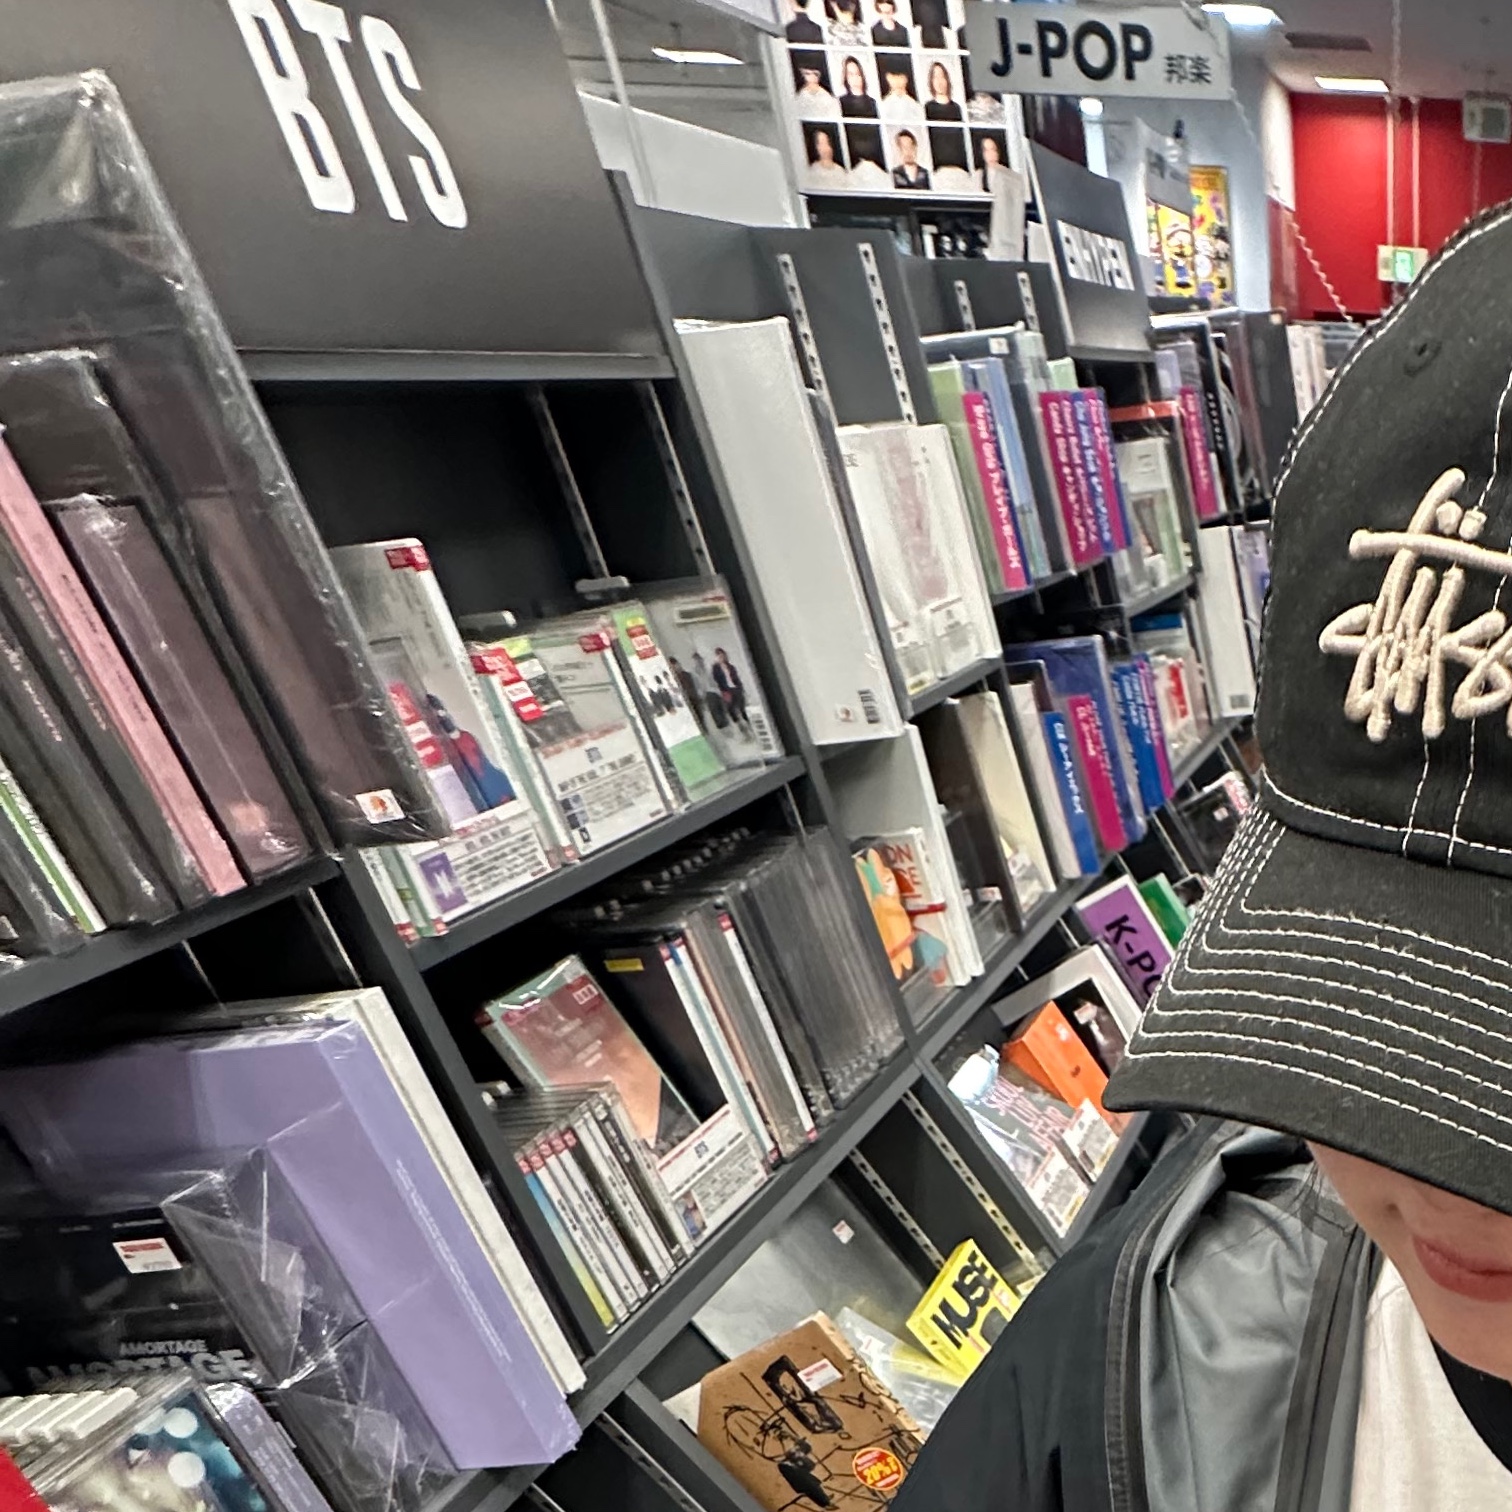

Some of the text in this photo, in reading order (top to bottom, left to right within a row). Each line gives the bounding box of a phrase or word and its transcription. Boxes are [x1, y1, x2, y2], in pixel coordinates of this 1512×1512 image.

[990, 18, 1154, 81] J-POP
[1164, 53, 1212, 85] 邦楽
[227, 0, 470, 229] BTS
[930, 1250, 998, 1350] MUSE
